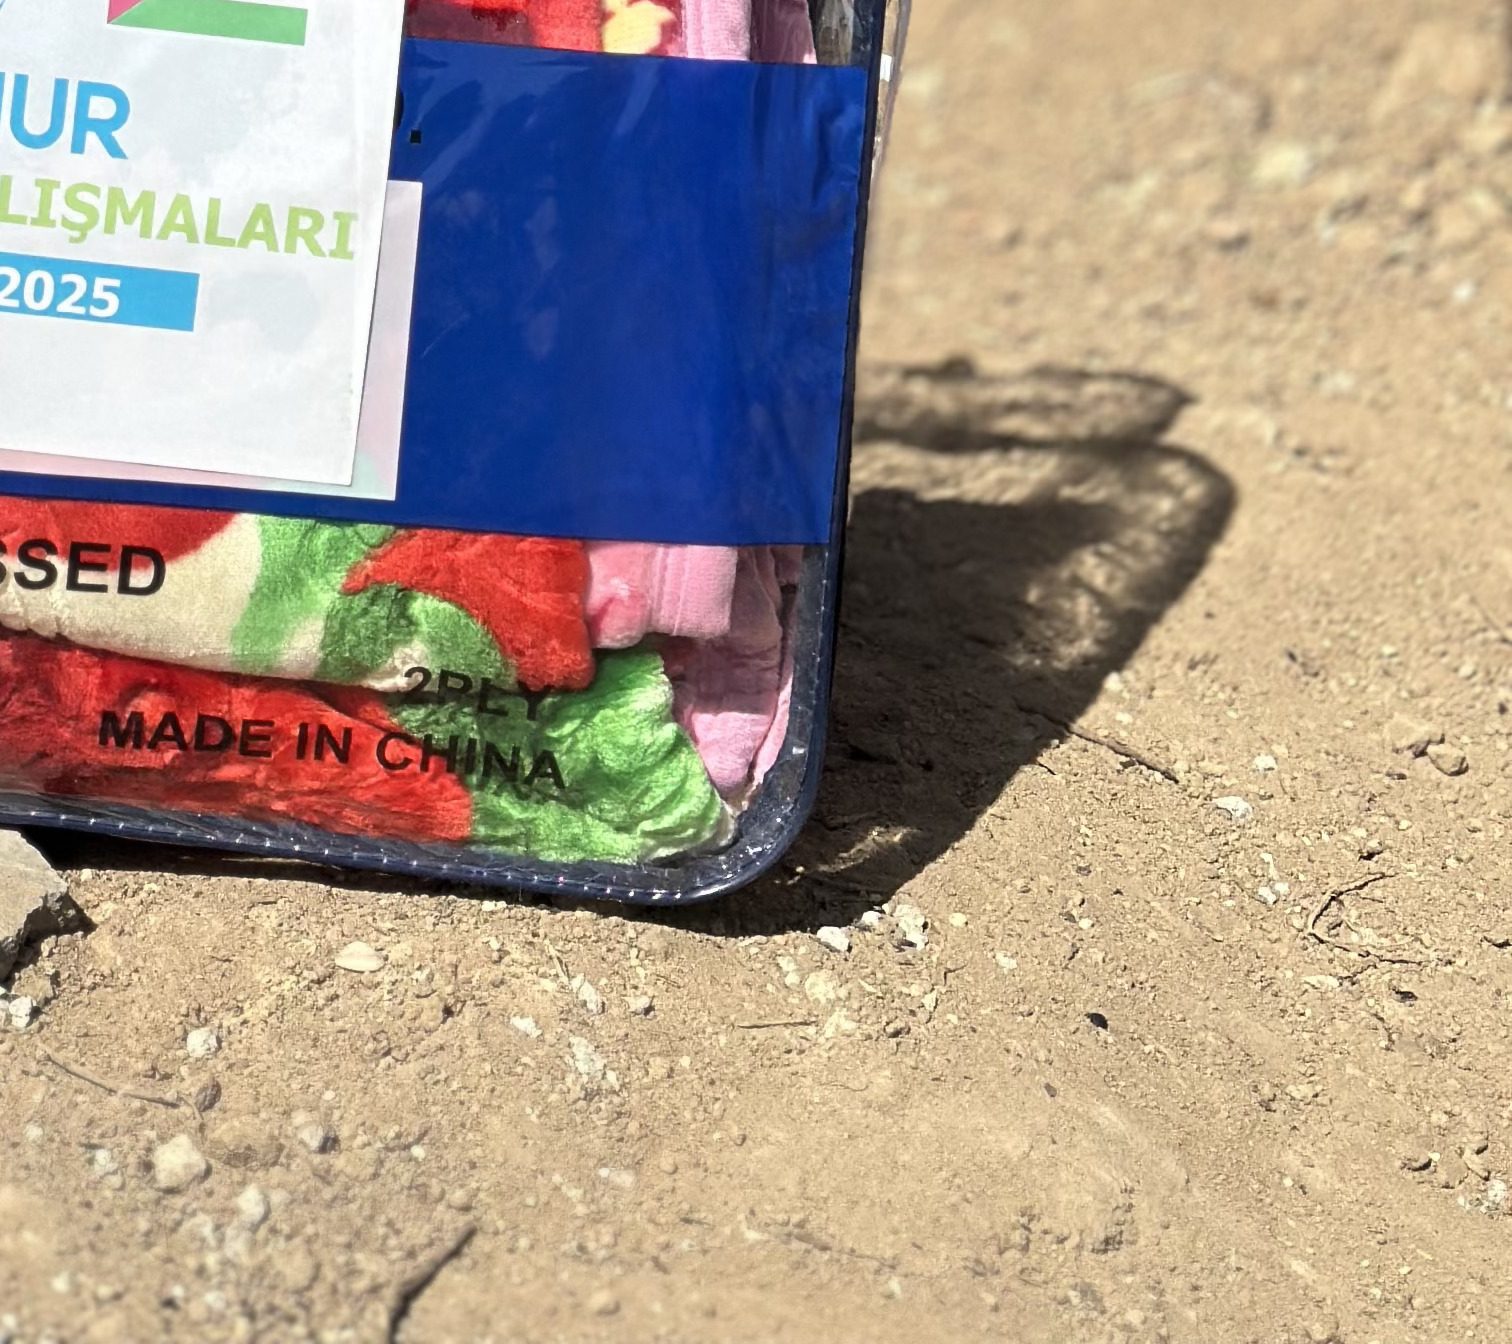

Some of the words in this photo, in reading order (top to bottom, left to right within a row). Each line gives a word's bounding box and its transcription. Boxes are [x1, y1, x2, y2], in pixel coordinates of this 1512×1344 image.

[397, 665, 555, 722] 2PLY
[97, 710, 276, 759] MADE
[295, 723, 353, 765] IN
[375, 731, 567, 791] CHINA
